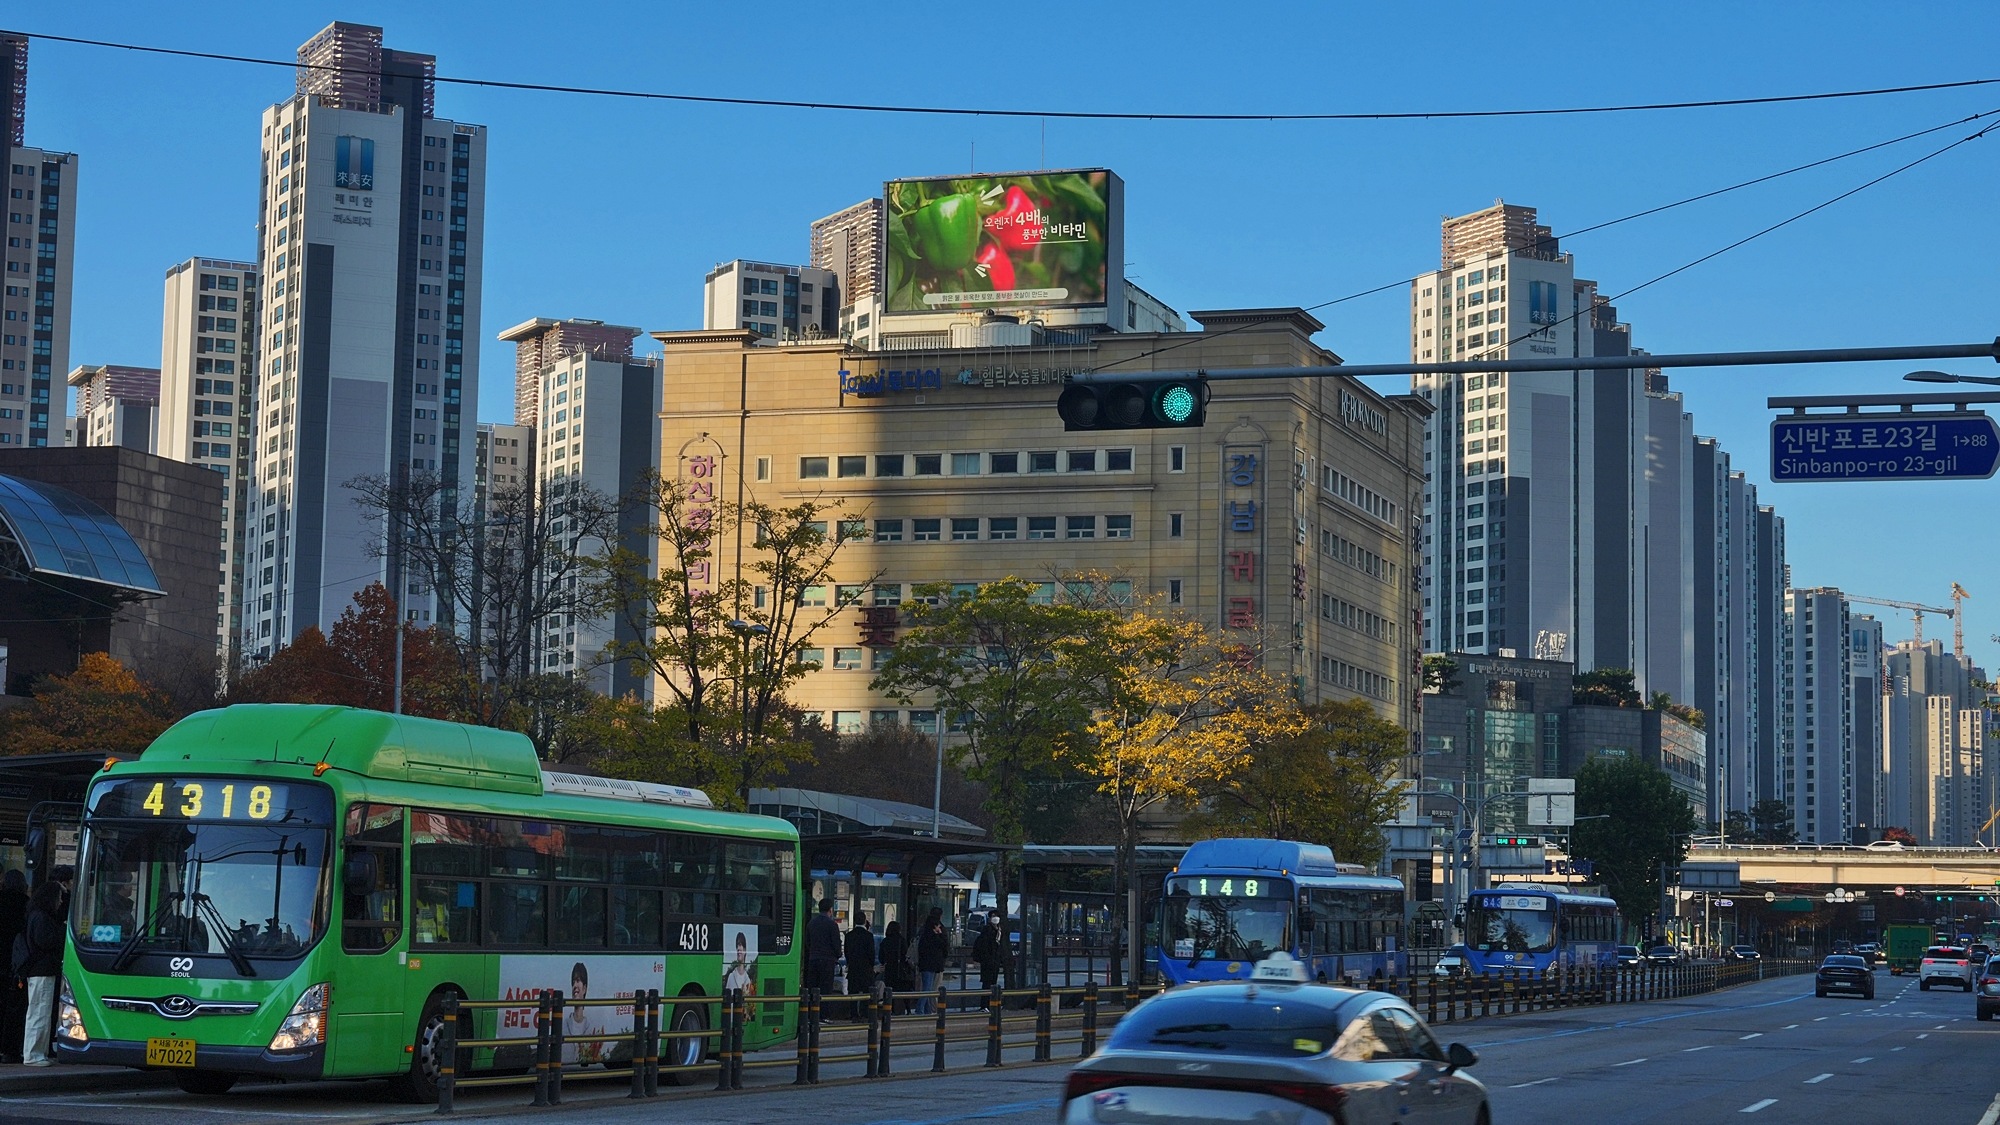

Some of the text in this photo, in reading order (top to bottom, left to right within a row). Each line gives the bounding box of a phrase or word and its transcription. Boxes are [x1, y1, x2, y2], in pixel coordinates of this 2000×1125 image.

[337, 171, 372, 187] 來美安
[335, 193, 373, 208] 래미안
[984, 209, 1049, 230] 오렌지 4배의
[1022, 222, 1086, 240] 풍부한 비타민
[1781, 424, 1937, 454] 신반포로23길
[1780, 455, 1958, 476] Sinbanpo-ro 23-gil
[854, 607, 901, 646] 꽃
[143, 782, 272, 819] 4318
[1200, 878, 1258, 897] 148
[1483, 897, 1501, 908] 643
[680, 923, 709, 950] 4318
[158, 1039, 171, 1047] 서울
